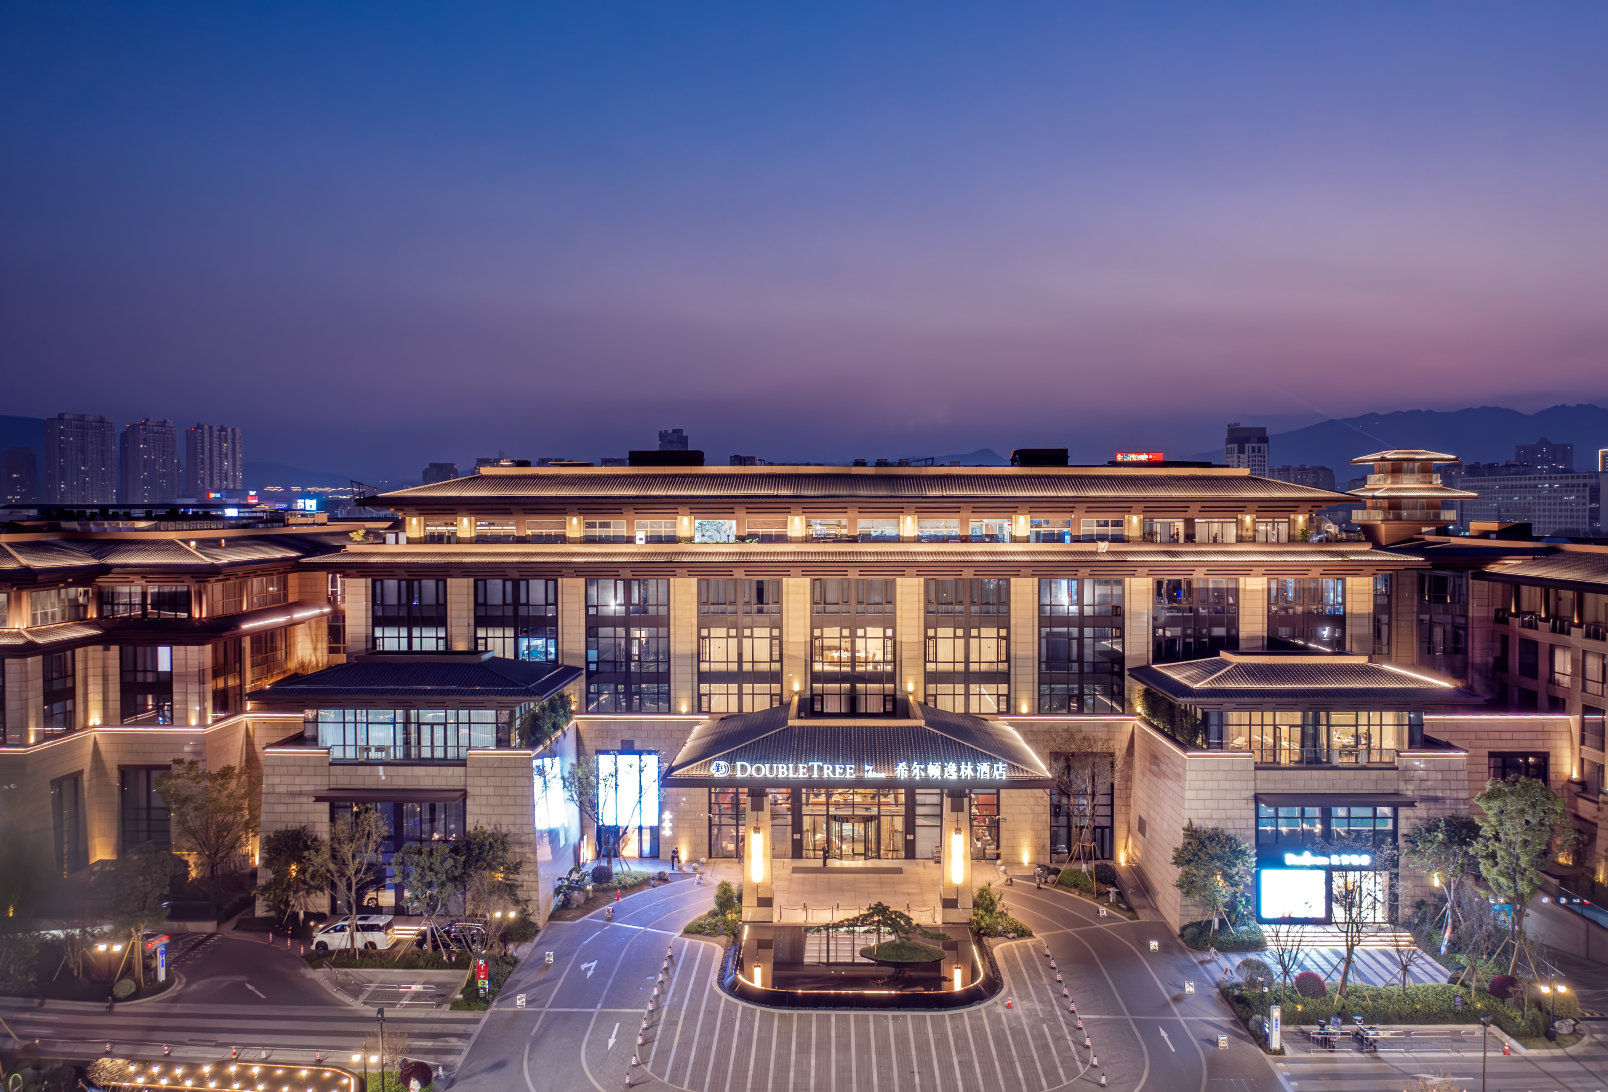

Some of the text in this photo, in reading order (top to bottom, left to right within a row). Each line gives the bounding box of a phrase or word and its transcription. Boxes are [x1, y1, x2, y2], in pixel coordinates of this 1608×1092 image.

[864, 770, 886, 778] Hilton
[894, 761, 1008, 779] 希尔顿逸林酒店
